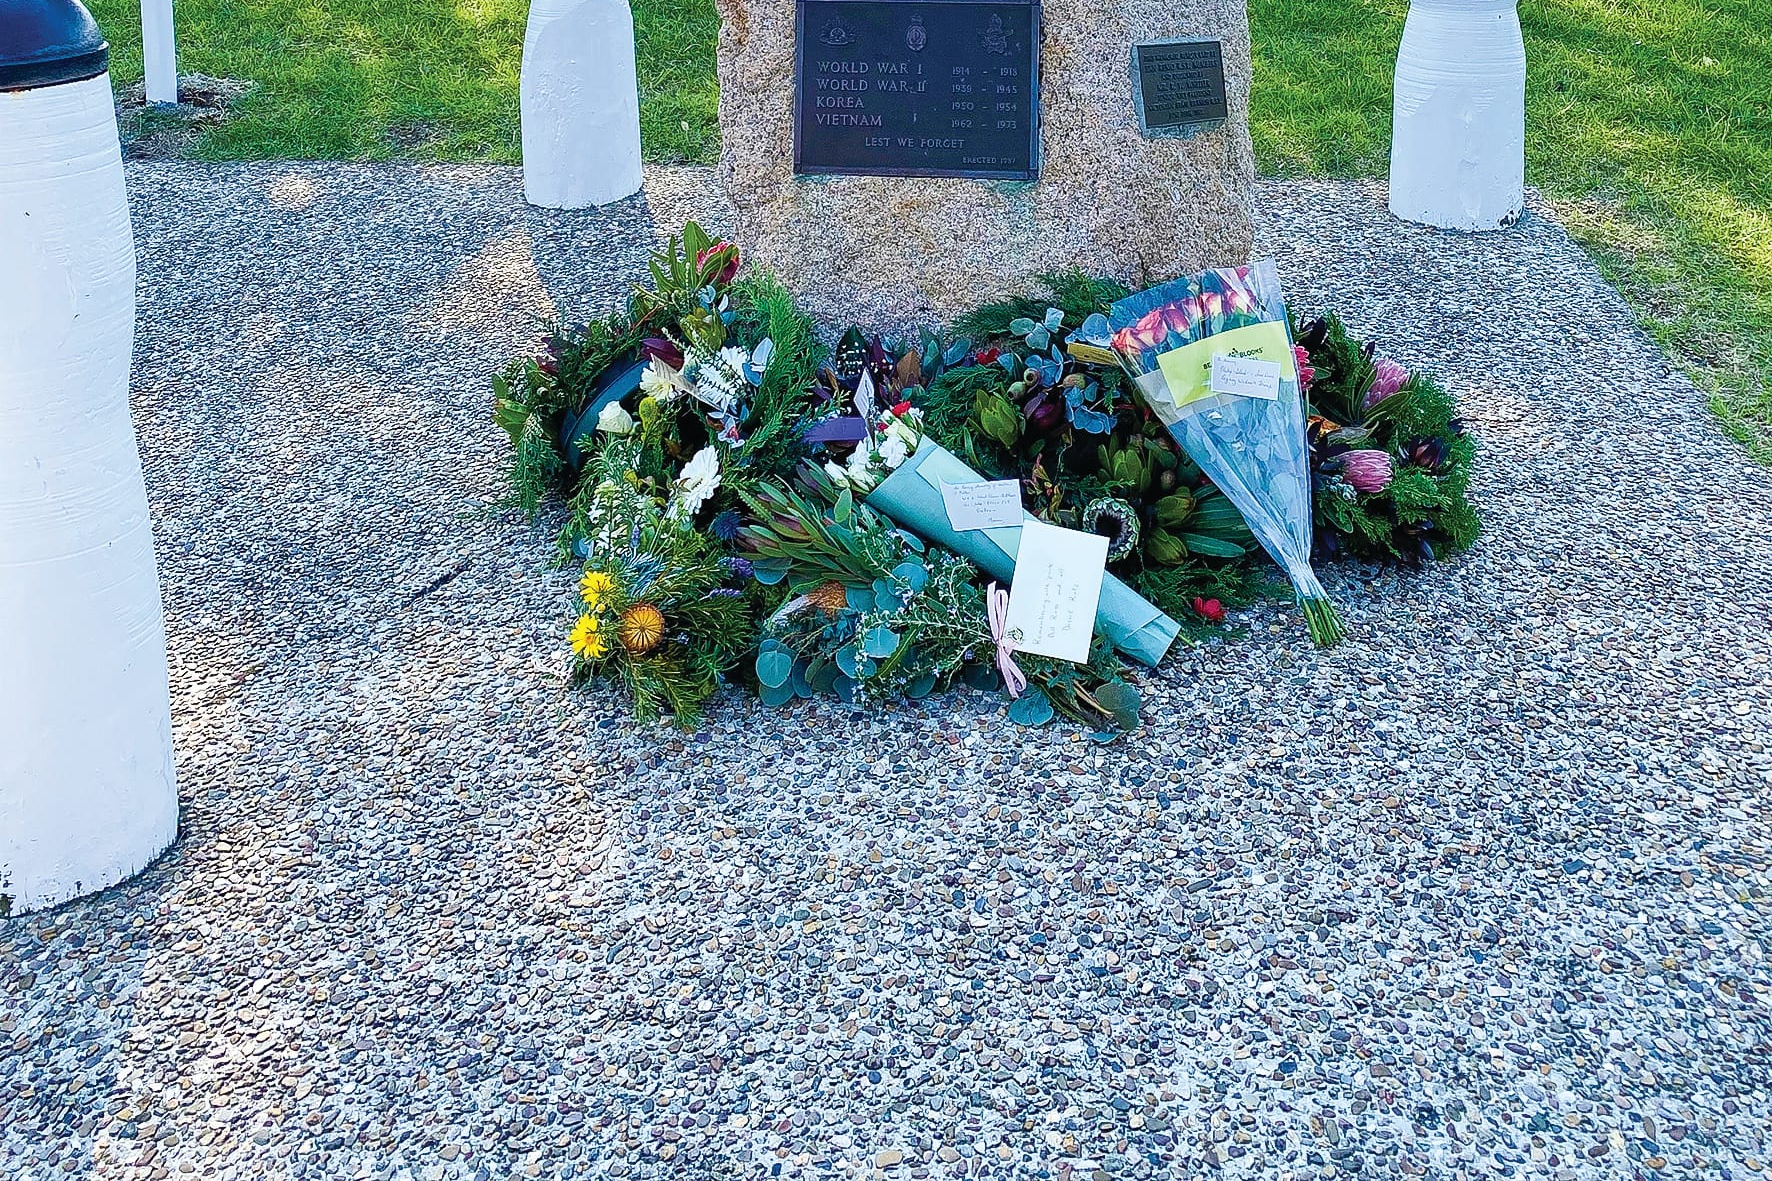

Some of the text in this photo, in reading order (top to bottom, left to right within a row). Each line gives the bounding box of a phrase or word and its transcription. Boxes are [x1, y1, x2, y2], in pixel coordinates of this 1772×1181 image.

[817, 61, 869, 74] WORLD
[877, 62, 909, 75] WAR
[917, 63, 923, 75] I
[952, 66, 970, 76] 1914
[1000, 67, 1018, 77] 1918
[816, 78, 869, 91] WORLD
[877, 80, 909, 92] WAR
[917, 81, 927, 92] II
[952, 84, 972, 94] 1939
[996, 84, 1018, 94] 1945
[816, 97, 865, 109] KOREA
[951, 102, 975, 111] 1950
[996, 103, 1017, 112] 1954
[816, 114, 882, 127] VIETNAM
[951, 120, 972, 129] 1962
[996, 121, 1018, 130] 1973
[865, 137, 966, 149] LEST WE FORGET
[1240, 347, 1262, 358] BLOOMS
